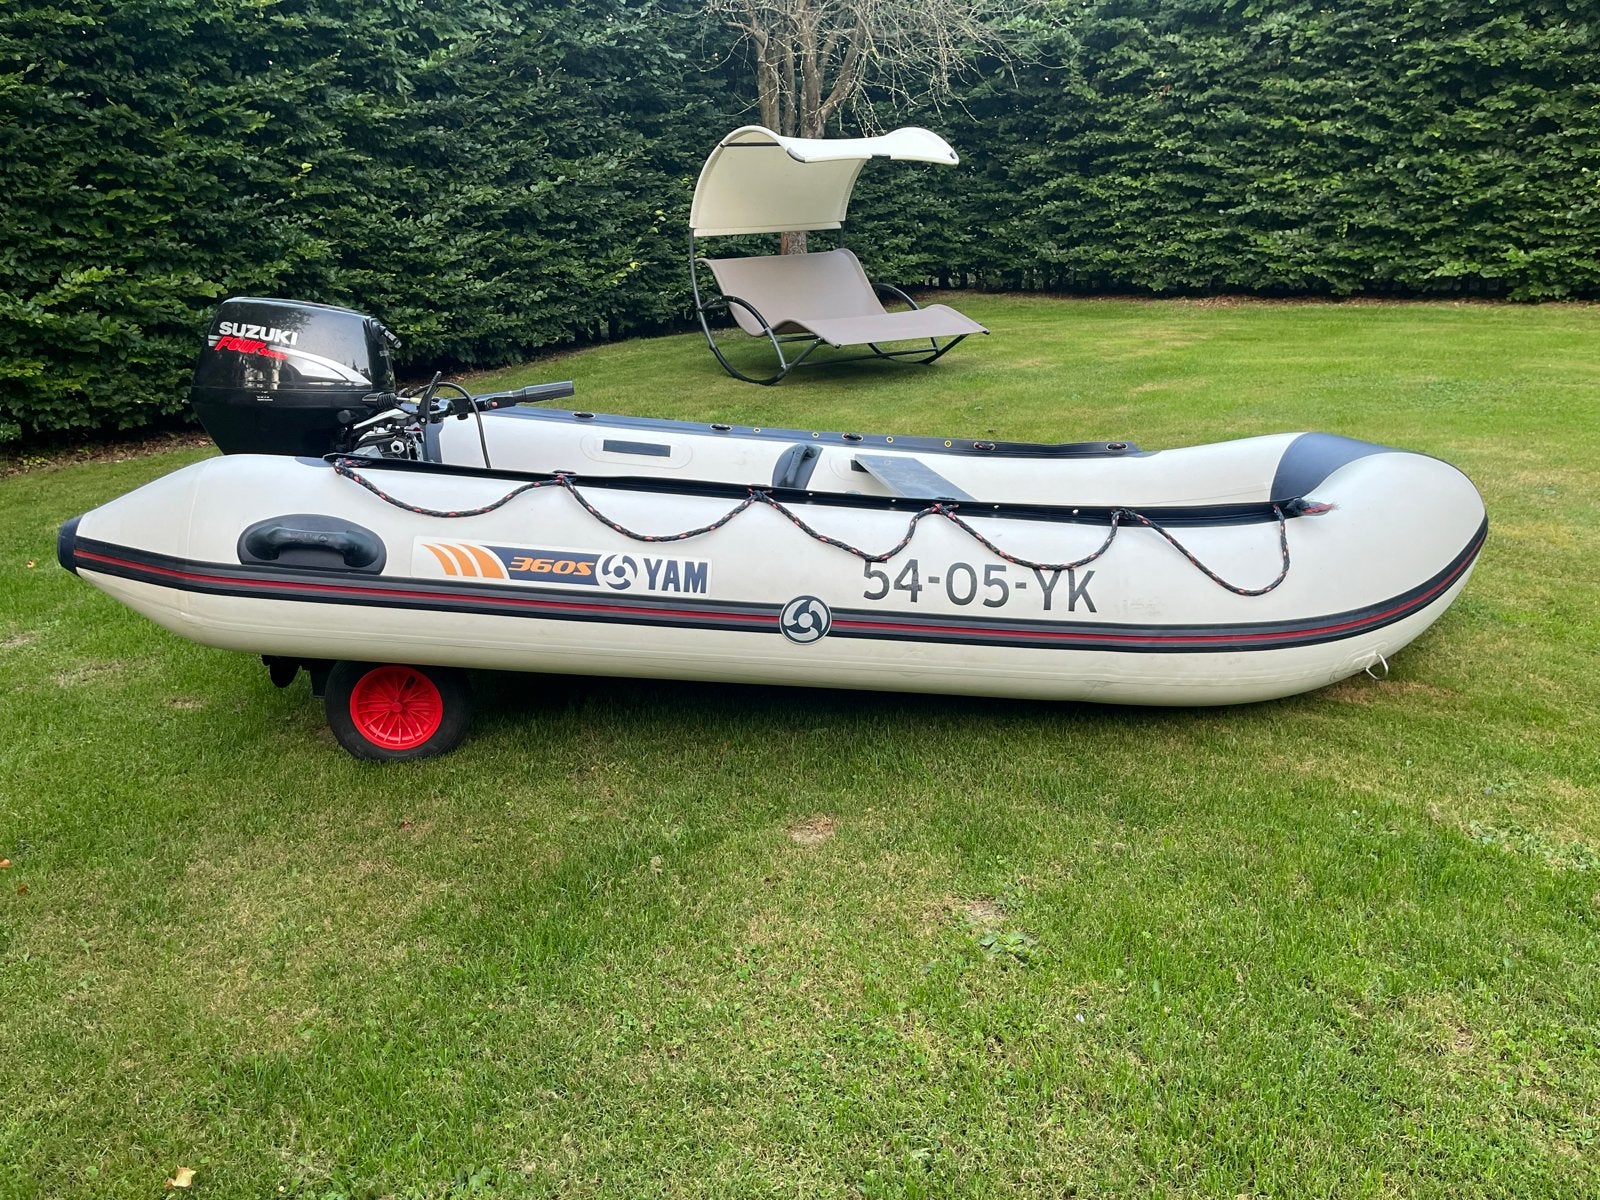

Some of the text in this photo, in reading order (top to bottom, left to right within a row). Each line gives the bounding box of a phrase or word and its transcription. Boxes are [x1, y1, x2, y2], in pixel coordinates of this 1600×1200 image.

[219, 321, 298, 345] SUZUKI
[508, 556, 707, 594] 360S YAM
[863, 558, 1097, 613] 54-05-YK
